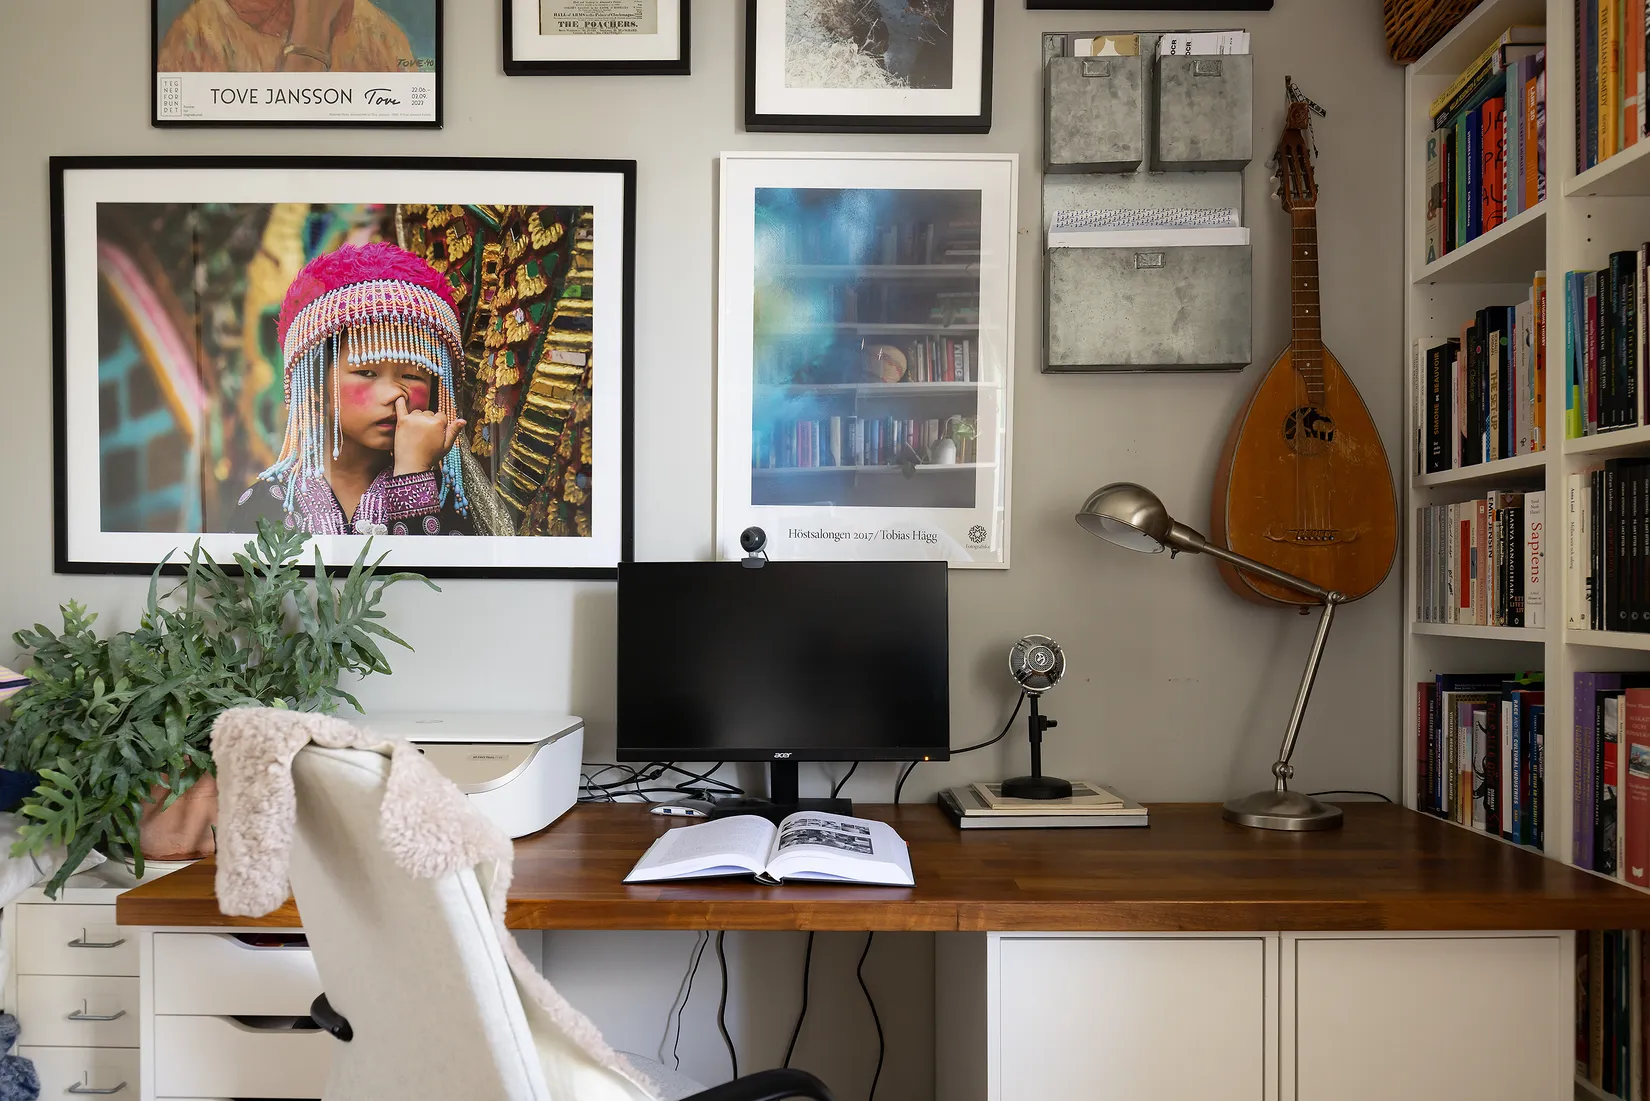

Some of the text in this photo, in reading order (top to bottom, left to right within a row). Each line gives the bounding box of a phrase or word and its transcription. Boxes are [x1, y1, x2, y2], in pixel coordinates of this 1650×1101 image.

[210, 88, 352, 105] TOVE JANSSON
[364, 88, 401, 106] Tove
[1490, 370, 1498, 430] THE SET-UP
[788, 528, 850, 543] Höstsalongen
[912, 530, 938, 544] Hägg
[1528, 522, 1543, 583] Sapiens
